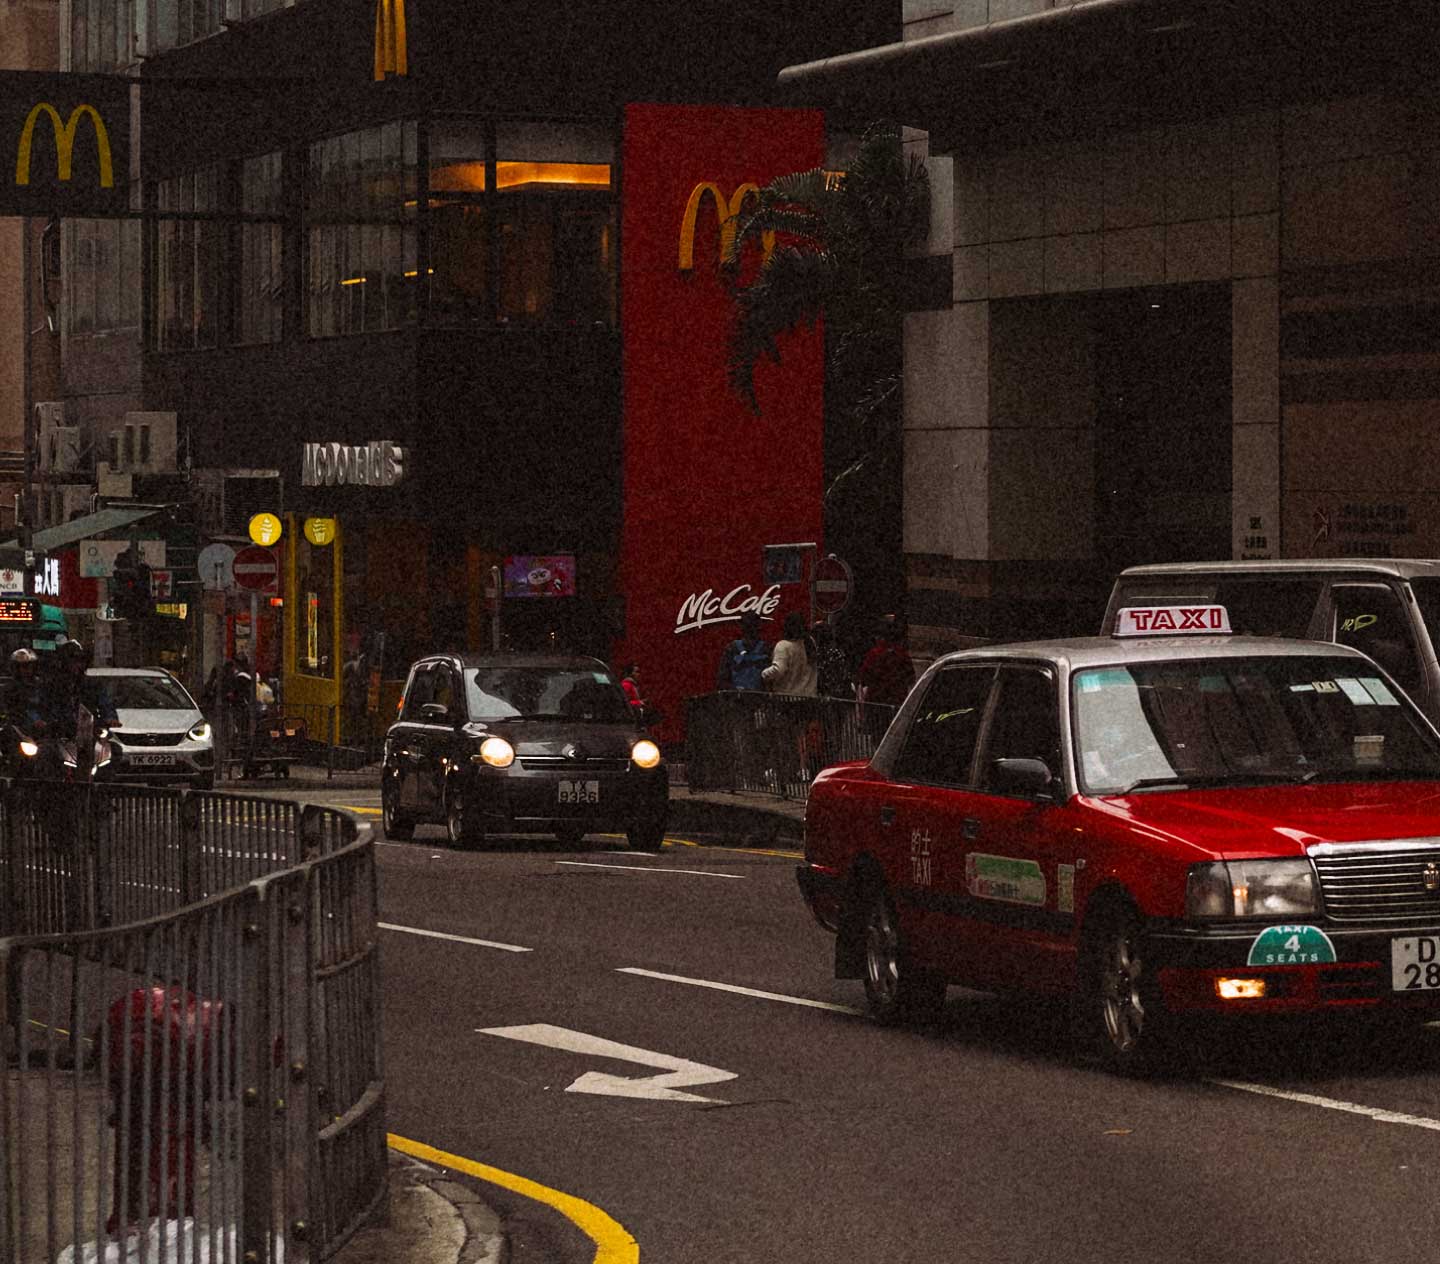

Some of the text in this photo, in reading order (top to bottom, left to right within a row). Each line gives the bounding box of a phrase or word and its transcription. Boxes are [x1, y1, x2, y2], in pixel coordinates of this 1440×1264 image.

[676, 584, 781, 629] McCafé
[1130, 608, 1222, 630] TAXI
[560, 791, 597, 801] 9326
[1284, 934, 1300, 952] 4
[1266, 953, 1318, 963] SEATS
